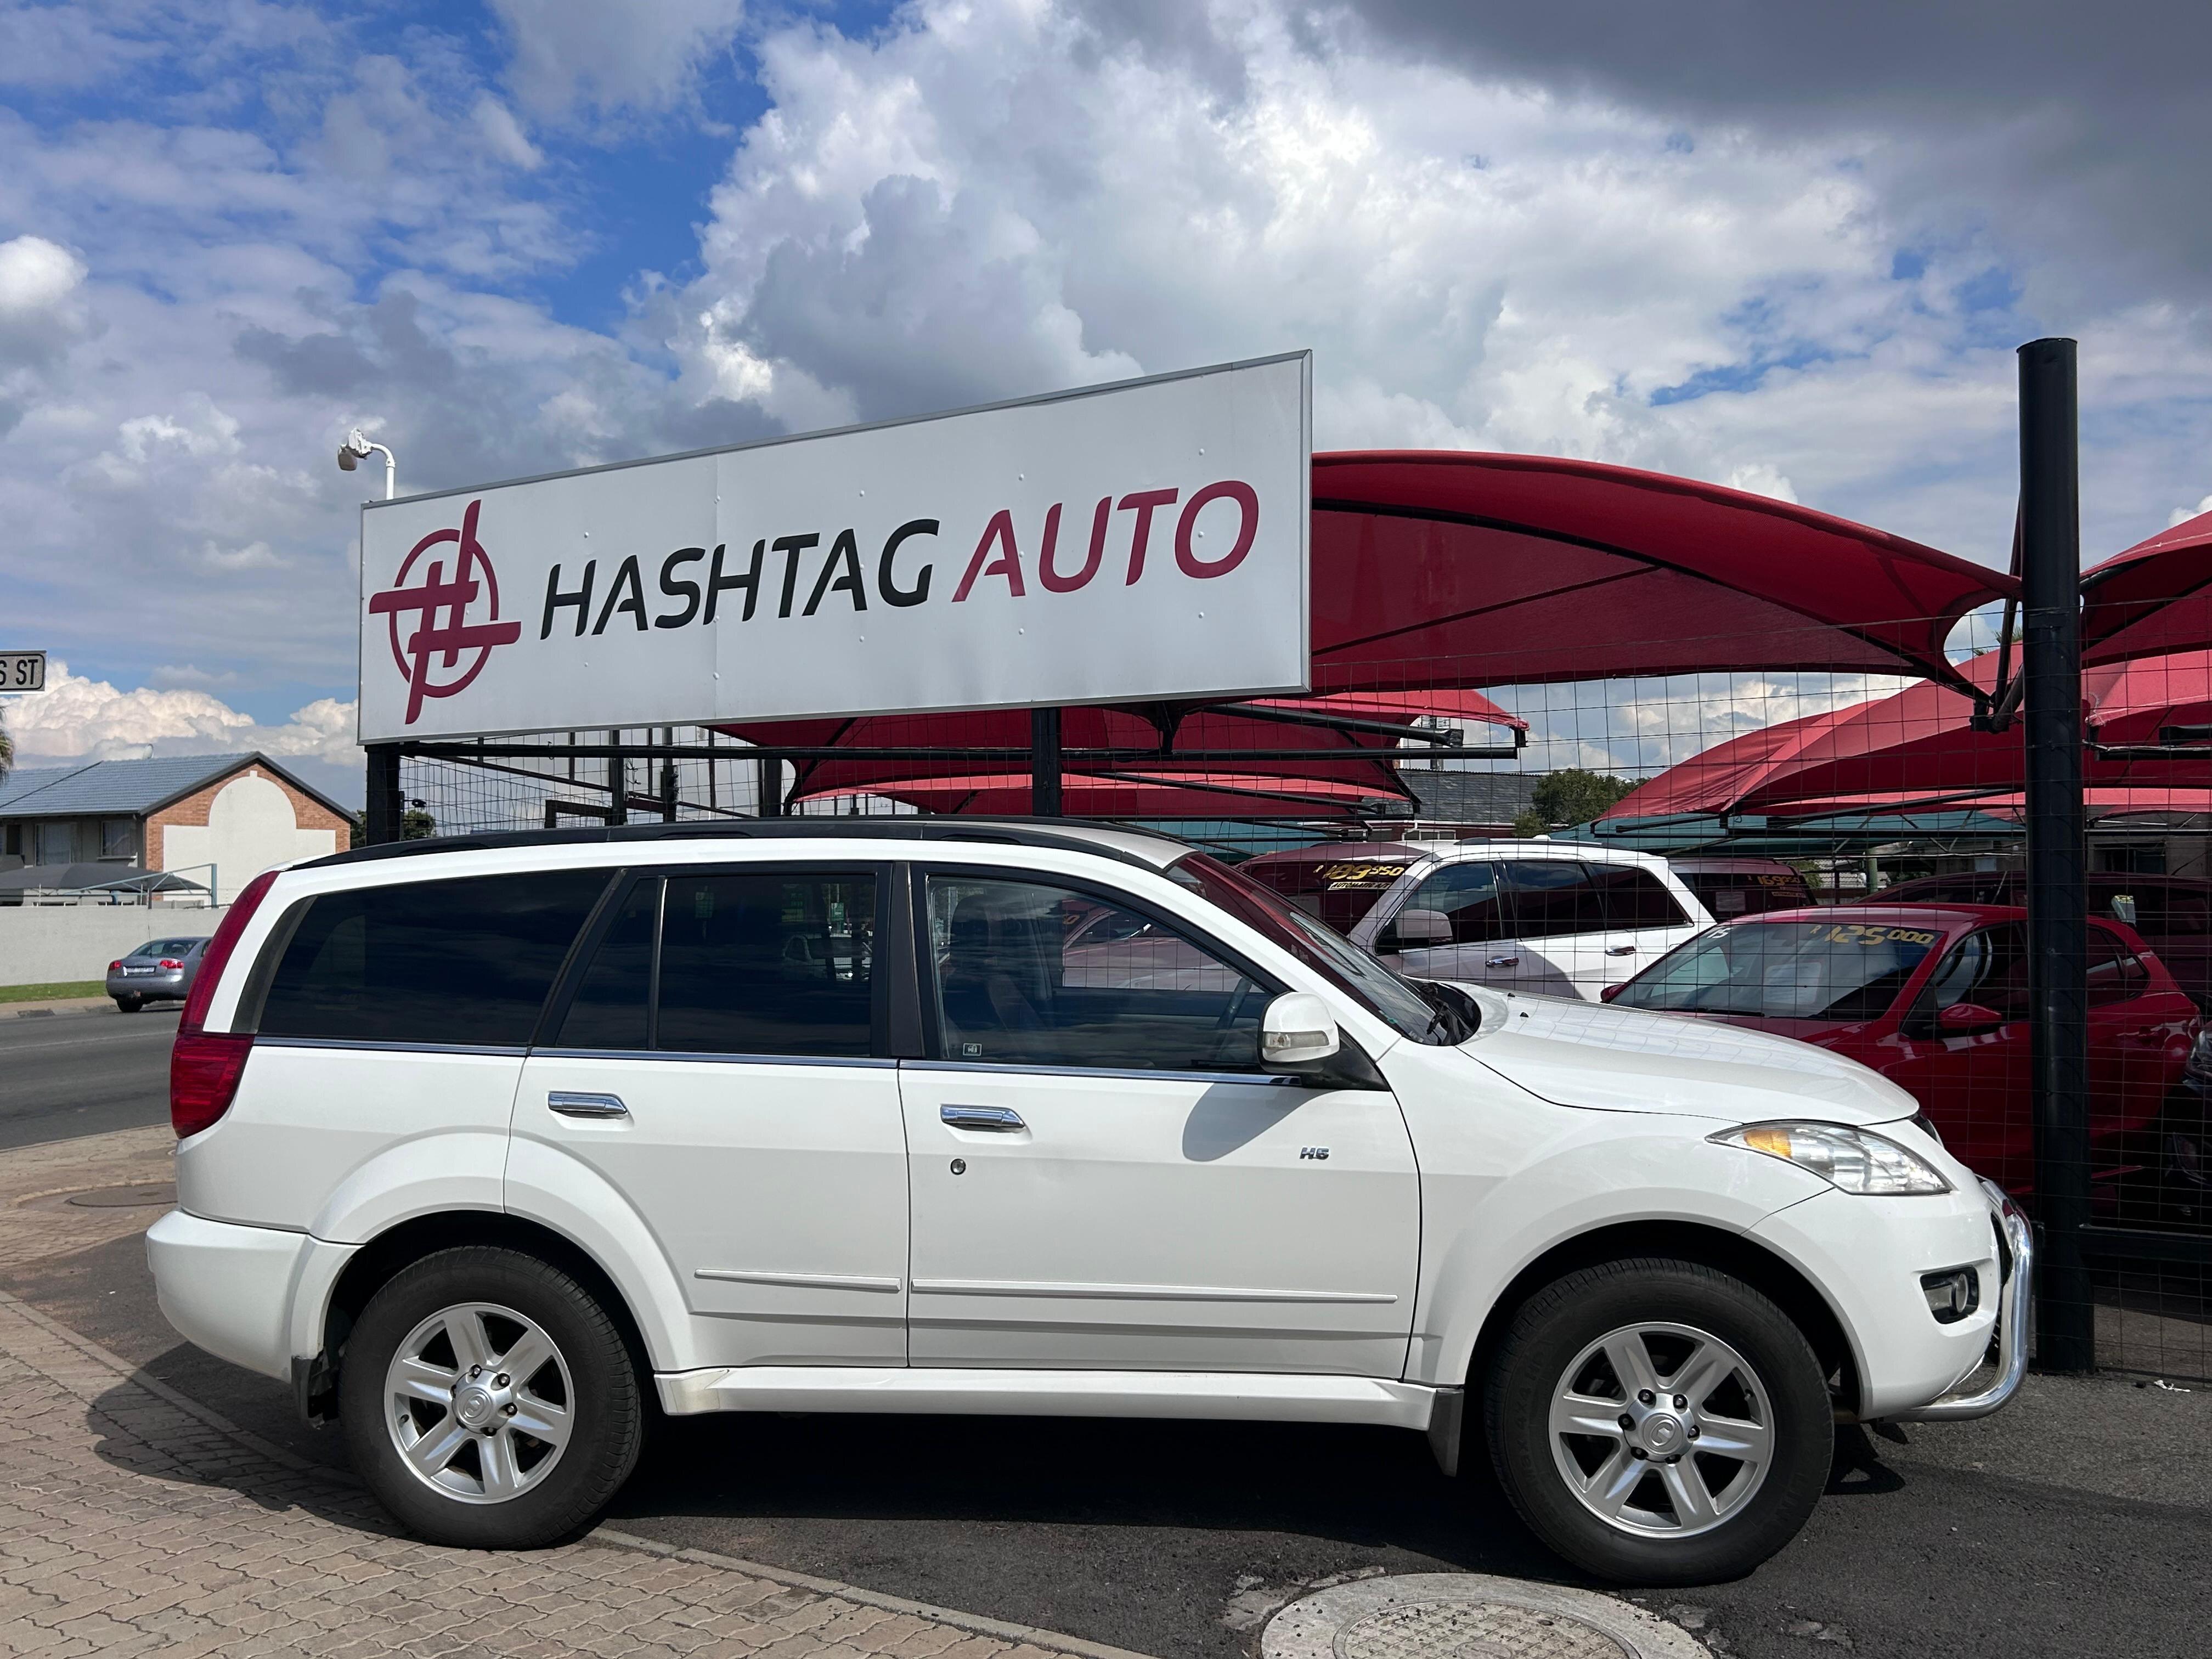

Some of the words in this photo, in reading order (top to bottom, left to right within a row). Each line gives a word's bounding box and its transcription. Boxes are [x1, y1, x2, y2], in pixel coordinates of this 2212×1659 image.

[540, 519, 940, 640] HASHTAG
[951, 480, 1259, 603] AUTO
[16, 659, 38, 685] ST
